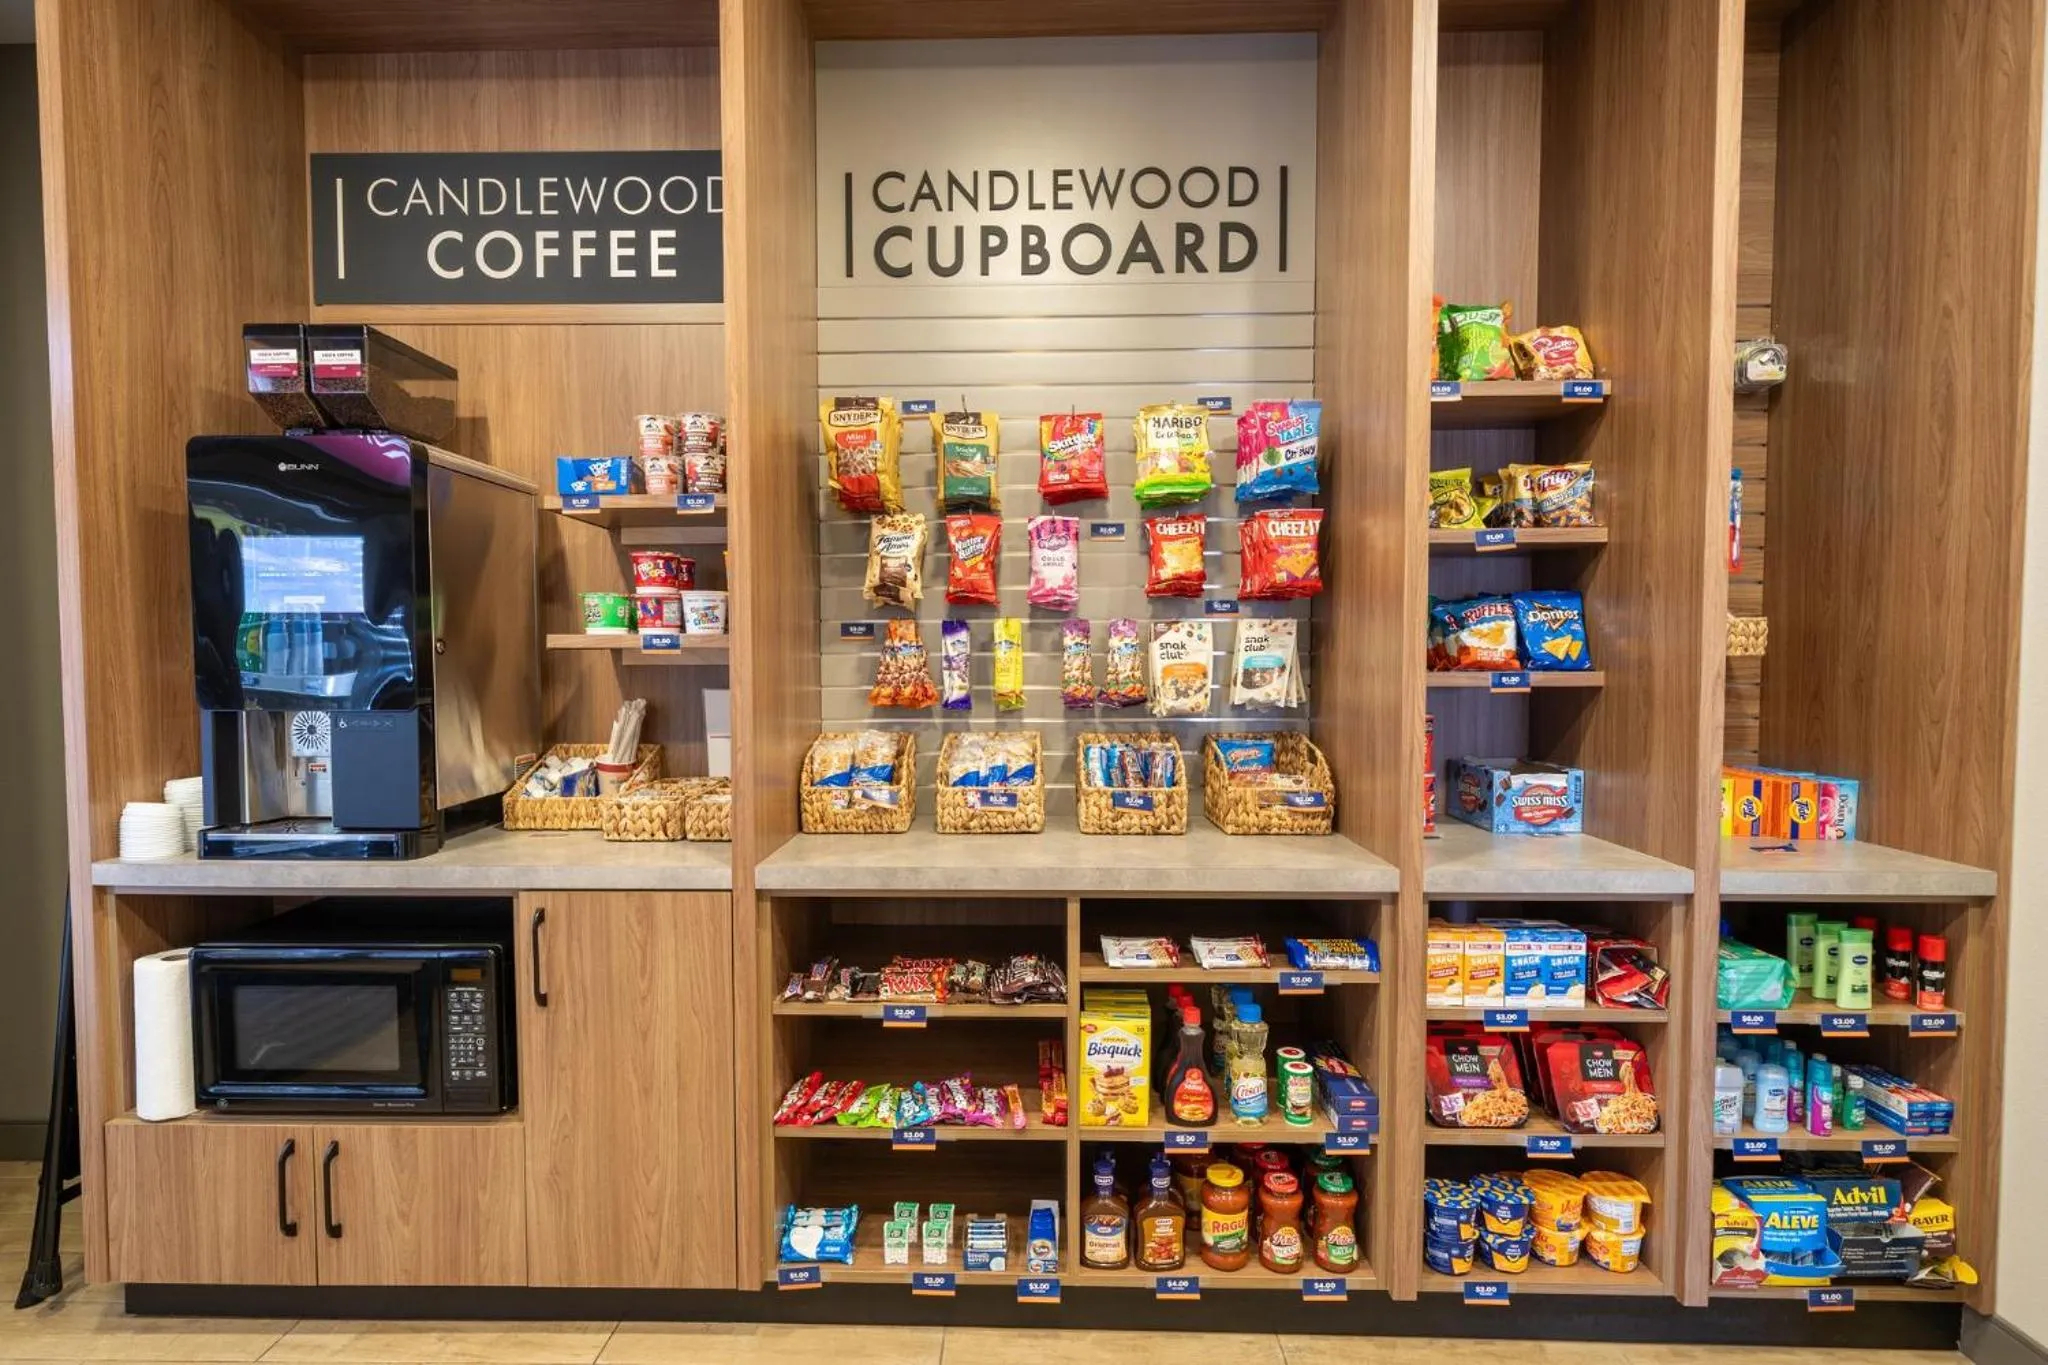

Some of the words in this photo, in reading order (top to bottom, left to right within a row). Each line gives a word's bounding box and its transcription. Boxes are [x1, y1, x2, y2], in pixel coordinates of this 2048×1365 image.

[872, 165, 1261, 214] CANDLEWOOD
[426, 229, 678, 281] COFFEE
[873, 220, 1259, 279] CUPBOARD
[1528, 608, 1579, 623] Doritos
[1159, 640, 1187, 651] snak
[1244, 636, 1270, 644] snak
[1244, 643, 1266, 653] club
[1511, 956, 1540, 966] SNACK
[1551, 956, 1580, 966] SNACK
[884, 972, 932, 993] TWIX
[1087, 1042, 1142, 1058] Bisquick
[1452, 1055, 1478, 1063] CHOW
[1586, 1059, 1613, 1068] CHOW
[1455, 1063, 1480, 1072] MEIN
[1588, 1068, 1613, 1077] MEIN
[1832, 1186, 1888, 1205] Advil
[1764, 1212, 1819, 1229] ALEVE
[1913, 1214, 1950, 1226] BAYER
